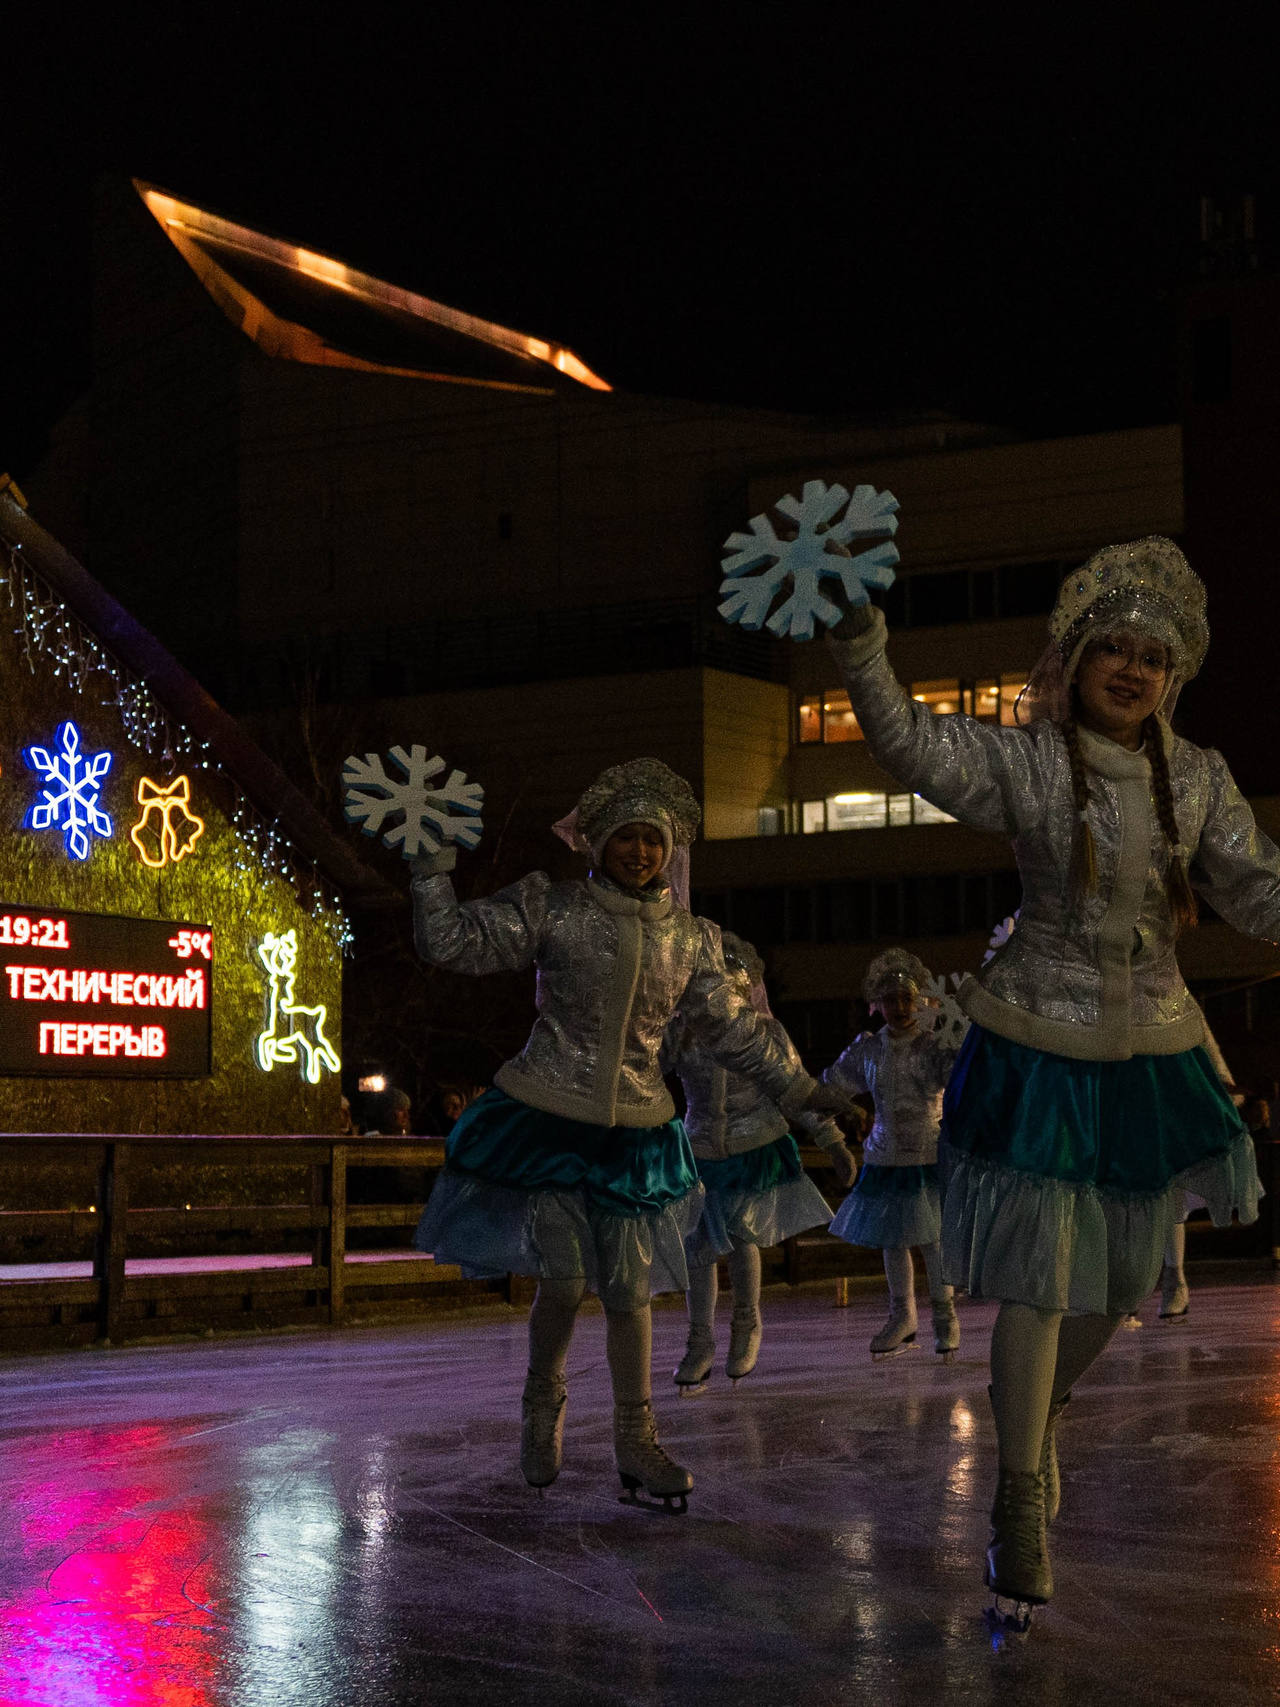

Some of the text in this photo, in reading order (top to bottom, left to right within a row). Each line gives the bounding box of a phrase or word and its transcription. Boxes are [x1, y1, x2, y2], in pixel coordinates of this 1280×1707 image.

[0, 914, 71, 949] 19:21
[4, 965, 206, 1009] ТЕХНИЧЕСКИЙ
[39, 1021, 167, 1058] ПЕРЕРЫВ
